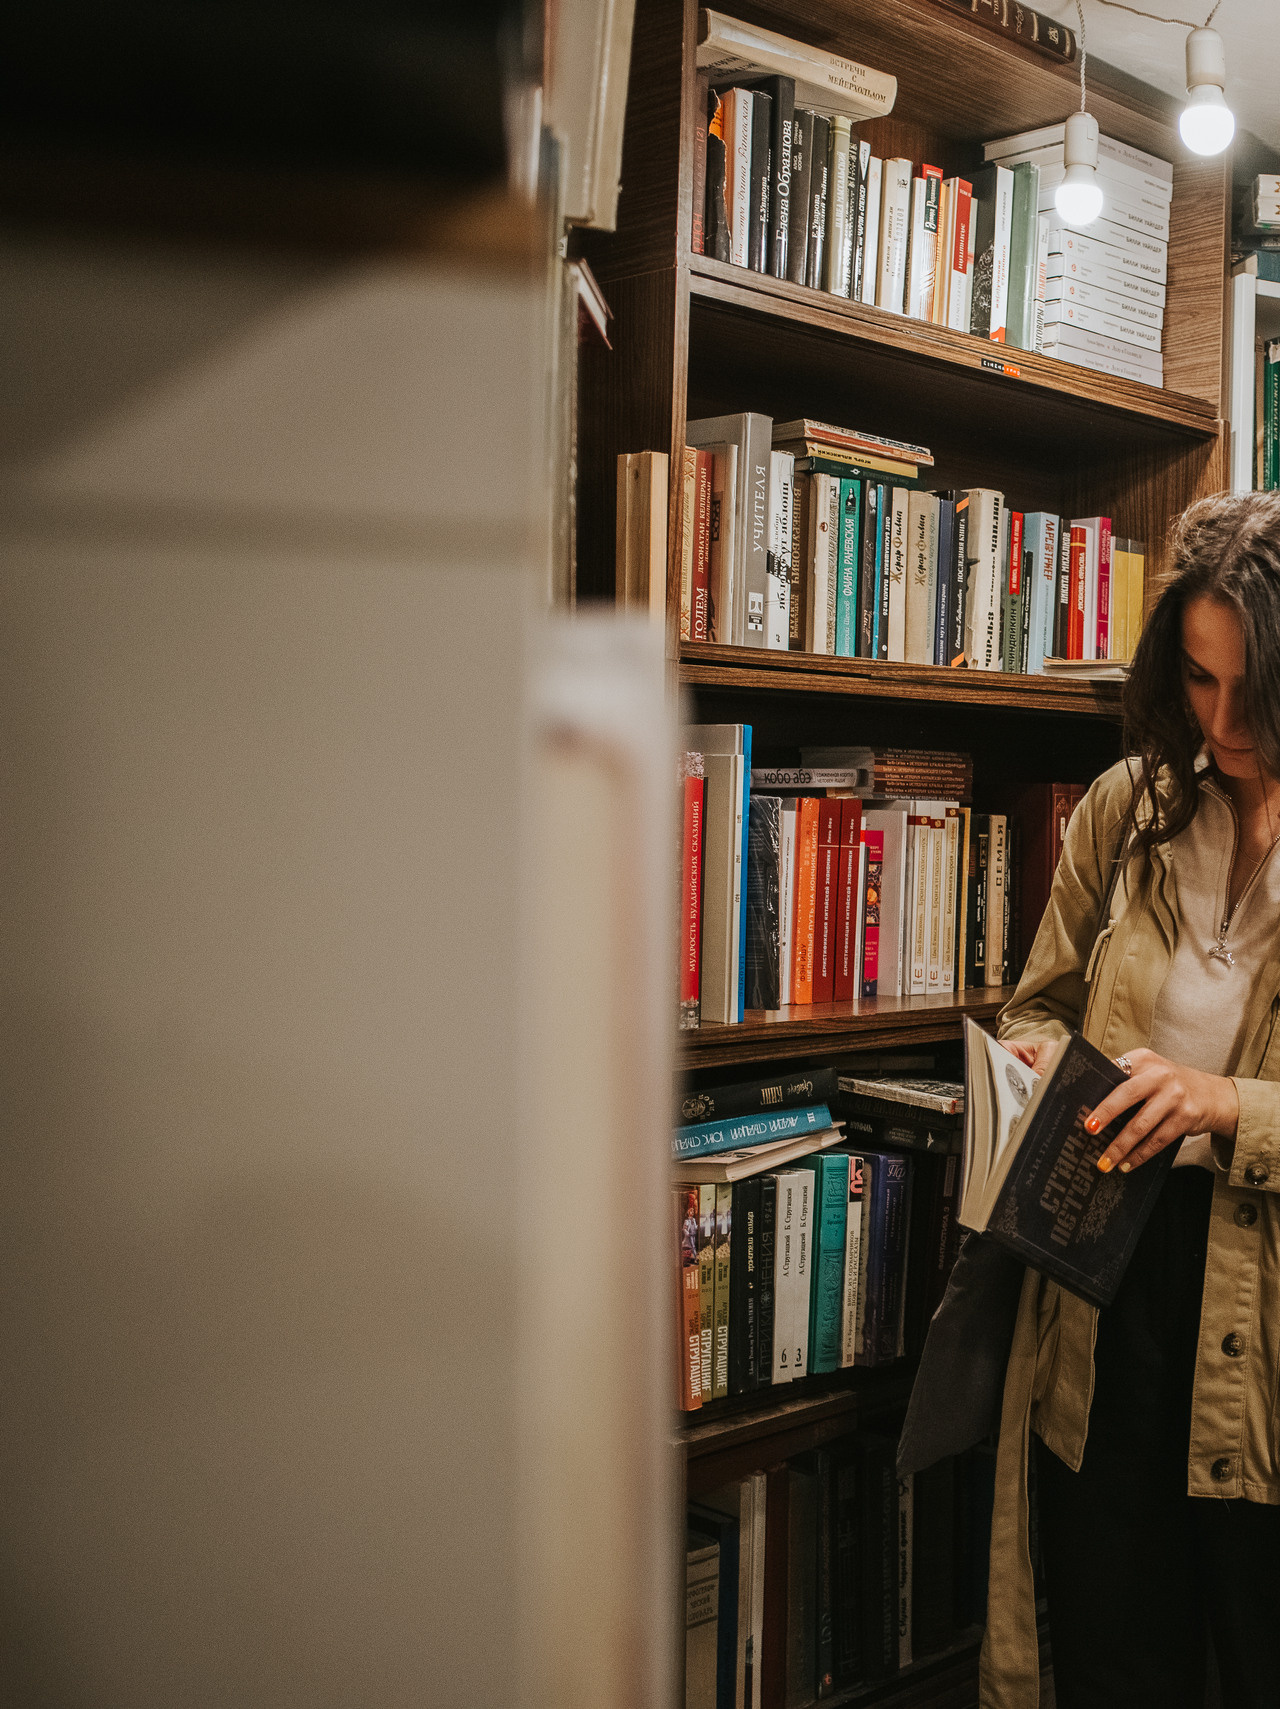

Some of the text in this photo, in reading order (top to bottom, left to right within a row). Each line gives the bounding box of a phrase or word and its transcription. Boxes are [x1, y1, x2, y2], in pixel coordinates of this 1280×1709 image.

[830, 57, 866, 77] ВСТРЕЧИ
[776, 120, 792, 241] Елена Образцова
[1126, 236, 1141, 246] БИЛЛИ
[1128, 214, 1143, 224] БИЛЛИ
[1120, 326, 1134, 335] БИЛЛИ
[1122, 304, 1136, 312] БИЛЛИ
[699, 467, 707, 519] КЕЛЛЕРМАН
[753, 464, 766, 552] УЧИТЕЛЯ
[890, 510, 904, 584] Жерар Филип
[914, 514, 927, 586] Жерар Филип
[957, 518, 966, 583] ПОСЛЕДНЯЯ КНИГА
[1060, 532, 1071, 604] НИКИТА МИХАЛКОВ
[693, 587, 705, 639] ГОЛЕМ
[764, 770, 812, 785] кобо абэ
[689, 800, 700, 972] МУДРОСТЬ БУДДИЙСКИХ СКАЗАНИЙ
[824, 850, 832, 884] ЭКОНОМИКИ
[996, 824, 1004, 887] СЕМЬЯ
[844, 886, 852, 920] КИТАЙСКОЙ
[689, 1335, 702, 1399] СТРУГАЦКИЕ
[701, 1329, 712, 1391] СТРУГАЦКИЕ
[717, 1326, 728, 1389] СТРУГАЦКИЕ
